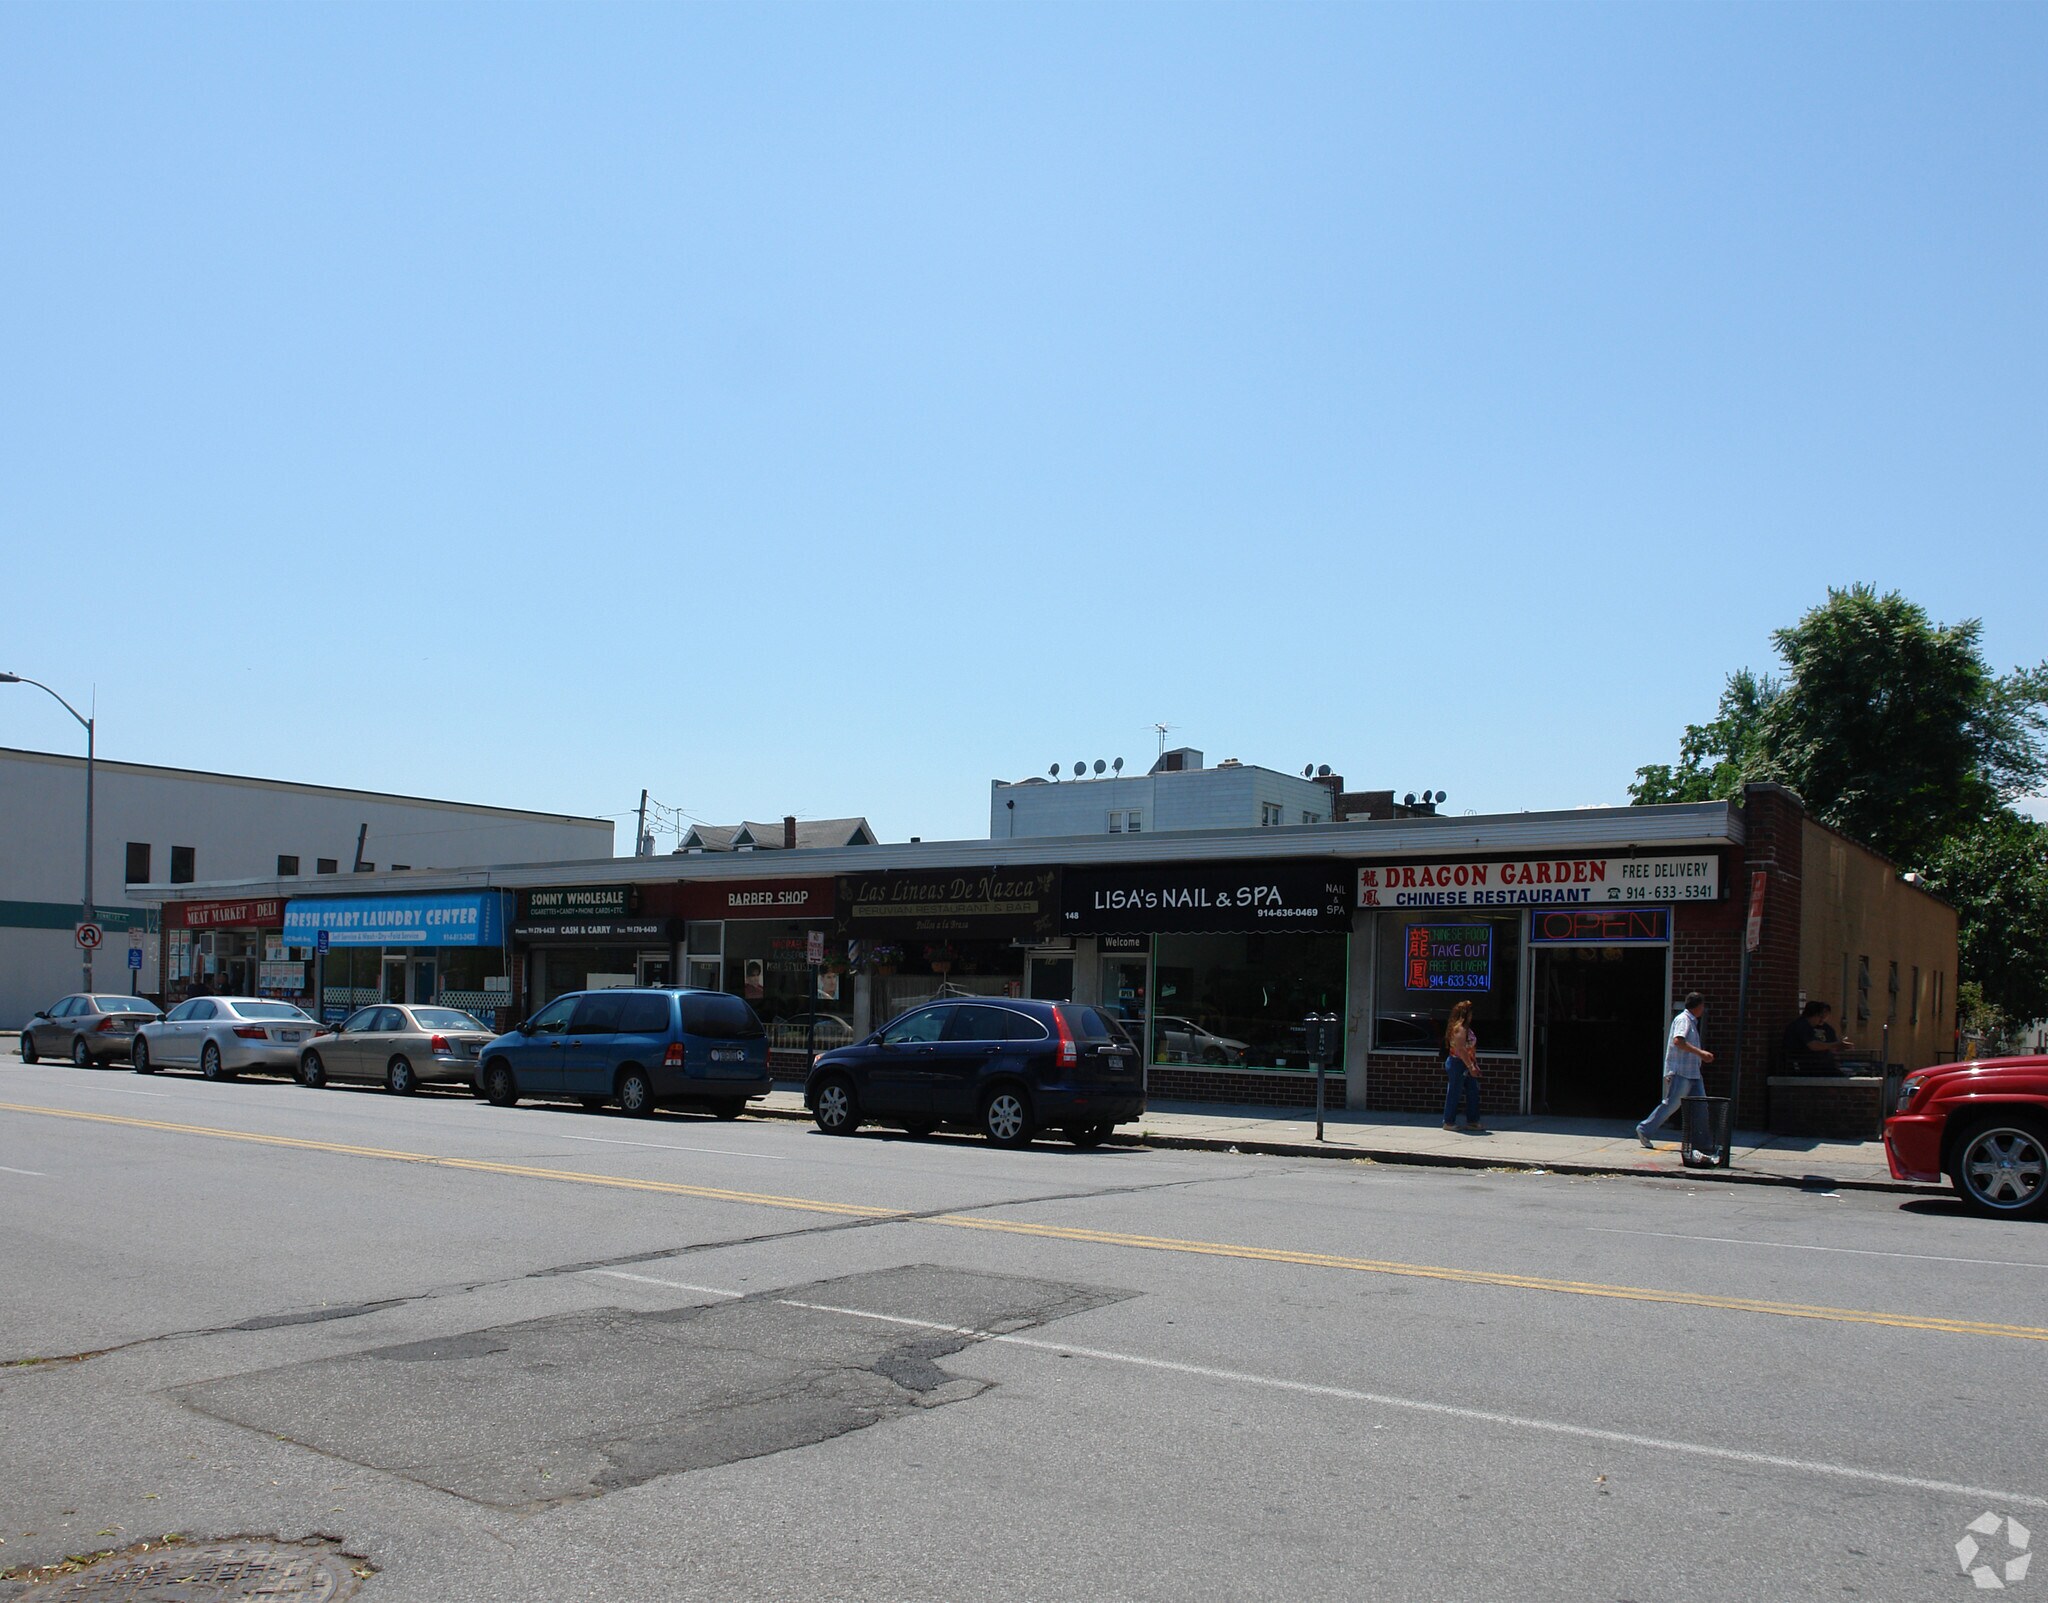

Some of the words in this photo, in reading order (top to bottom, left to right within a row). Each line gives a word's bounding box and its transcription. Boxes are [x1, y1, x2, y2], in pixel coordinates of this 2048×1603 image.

[1385, 865, 1488, 888] DRAGON
[1501, 861, 1606, 885] GARDEN
[1623, 864, 1650, 878] FREE
[1655, 862, 1708, 877] DELIVERY
[857, 881, 885, 902] Las
[890, 880, 944, 901] Lineas
[950, 878, 973, 900] De
[977, 874, 1034, 903] Nazca
[1325, 883, 1347, 895] NAIL
[531, 893, 563, 906] SONNY
[566, 891, 623, 905] WHOLESALE
[728, 892, 773, 906] BARBER
[778, 890, 809, 905] SHOP
[1094, 889, 1158, 910] LISA'S
[1162, 888, 1211, 908] NAIL
[1216, 892, 1232, 907] &
[1236, 886, 1283, 907] SPA
[1396, 891, 1467, 905] CHINESE
[1473, 888, 1591, 904] RESTAURANT
[187, 911, 209, 925] MEAT
[212, 906, 247, 922] MARKET
[257, 902, 277, 917] DELI
[858, 904, 912, 916] PERUVIAN
[916, 902, 989, 914] RESTAURANT
[1006, 902, 1031, 912] BAR
[1065, 911, 1079, 920] 148
[1257, 908, 1318, 918] 914-636-0469
[1326, 904, 1346, 916] SPA
[284, 912, 320, 927] FRESH
[323, 911, 360, 927] START
[362, 910, 422, 927] LAUNDRY
[425, 908, 477, 926] CENTER
[1543, 911, 1657, 939] OPEN
[560, 925, 579, 935] CASH
[580, 925, 585, 934] &
[587, 925, 611, 934] CARRY
[1105, 937, 1140, 947] Welcome
[1431, 944, 1462, 957] TAKE
[1464, 944, 1488, 957] OUT
[1429, 975, 1488, 987] 914-633-5341
